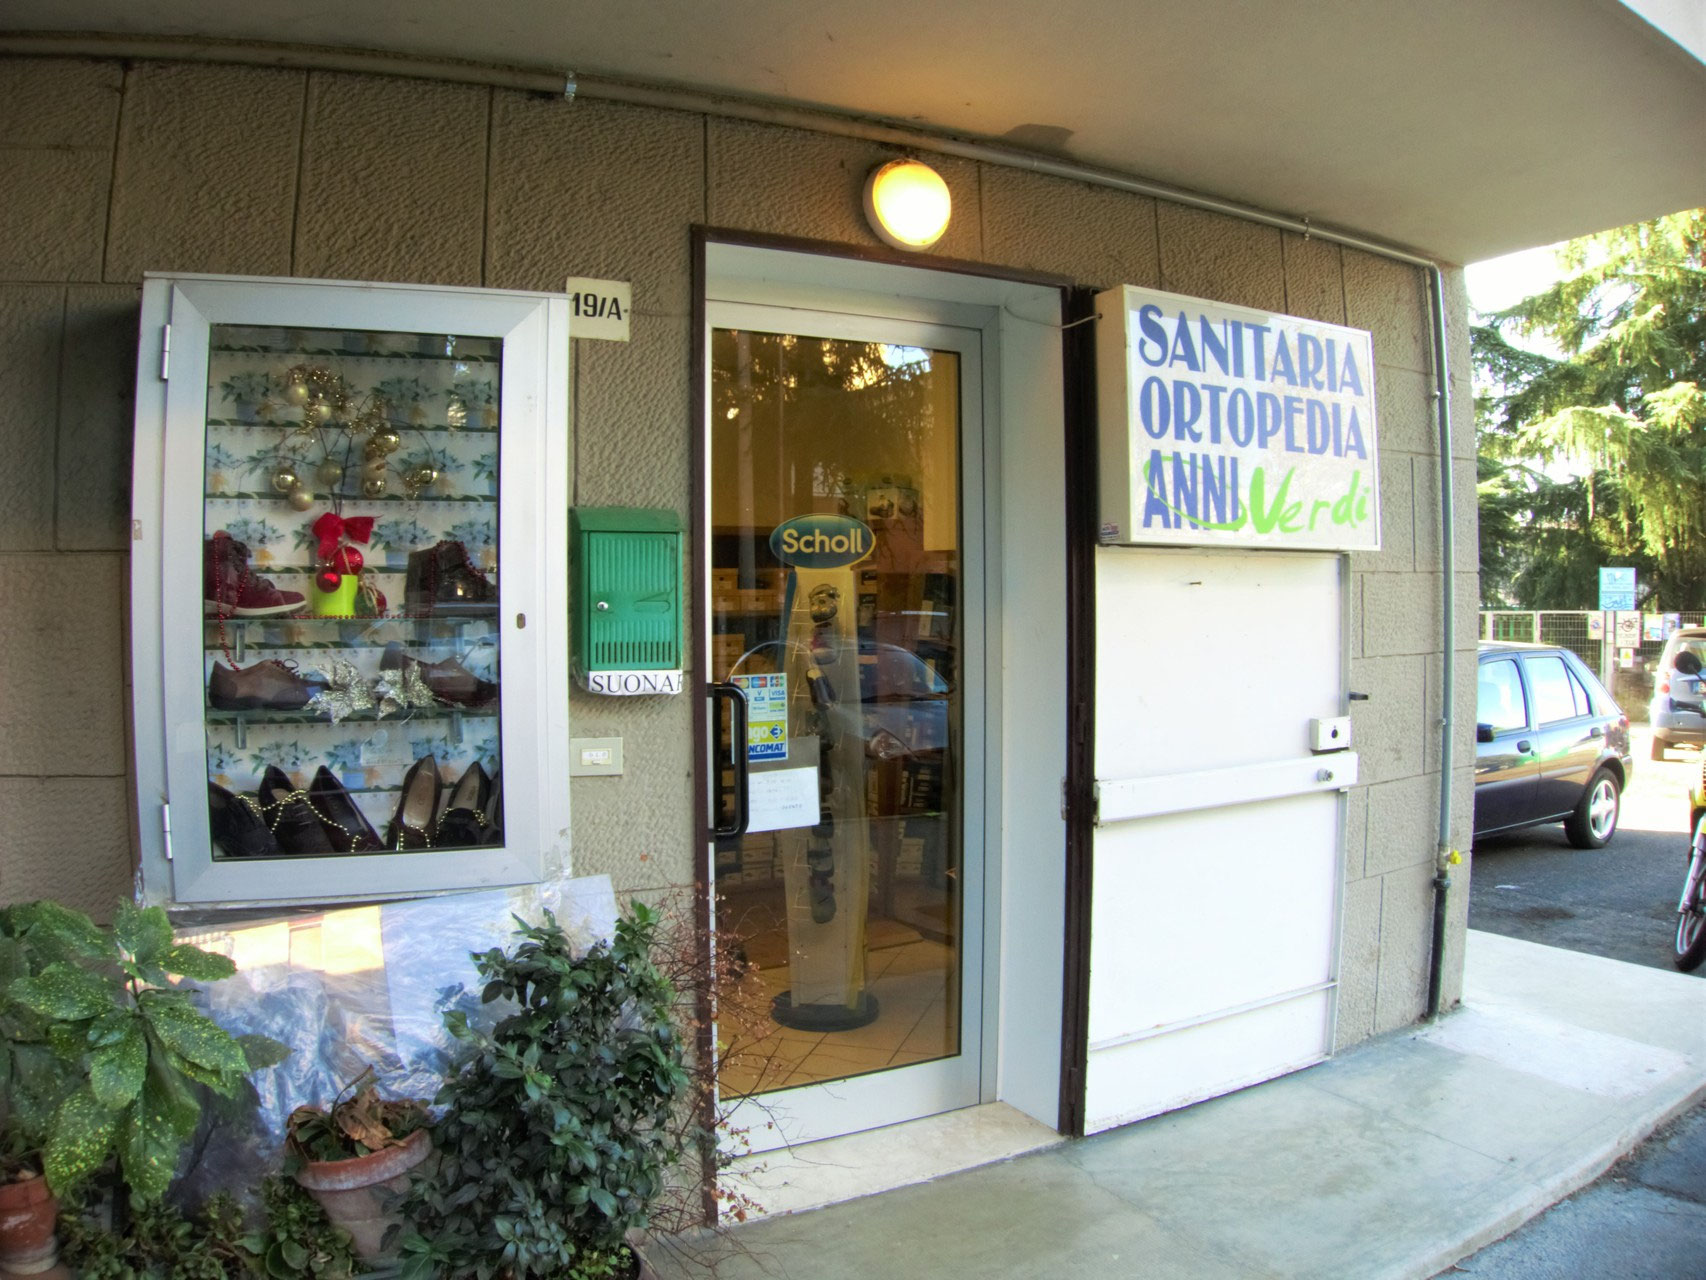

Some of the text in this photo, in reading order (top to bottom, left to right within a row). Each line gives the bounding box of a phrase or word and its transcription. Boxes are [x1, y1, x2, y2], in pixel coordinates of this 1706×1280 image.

[572, 293, 622, 320] 19/A
[1138, 304, 1364, 397] SANITARIA
[1140, 375, 1367, 460] ORTOPEDIA
[1143, 449, 1371, 534] ANNI Verdi
[782, 528, 863, 553] Scholl
[749, 743, 784, 753] NCOMAT
